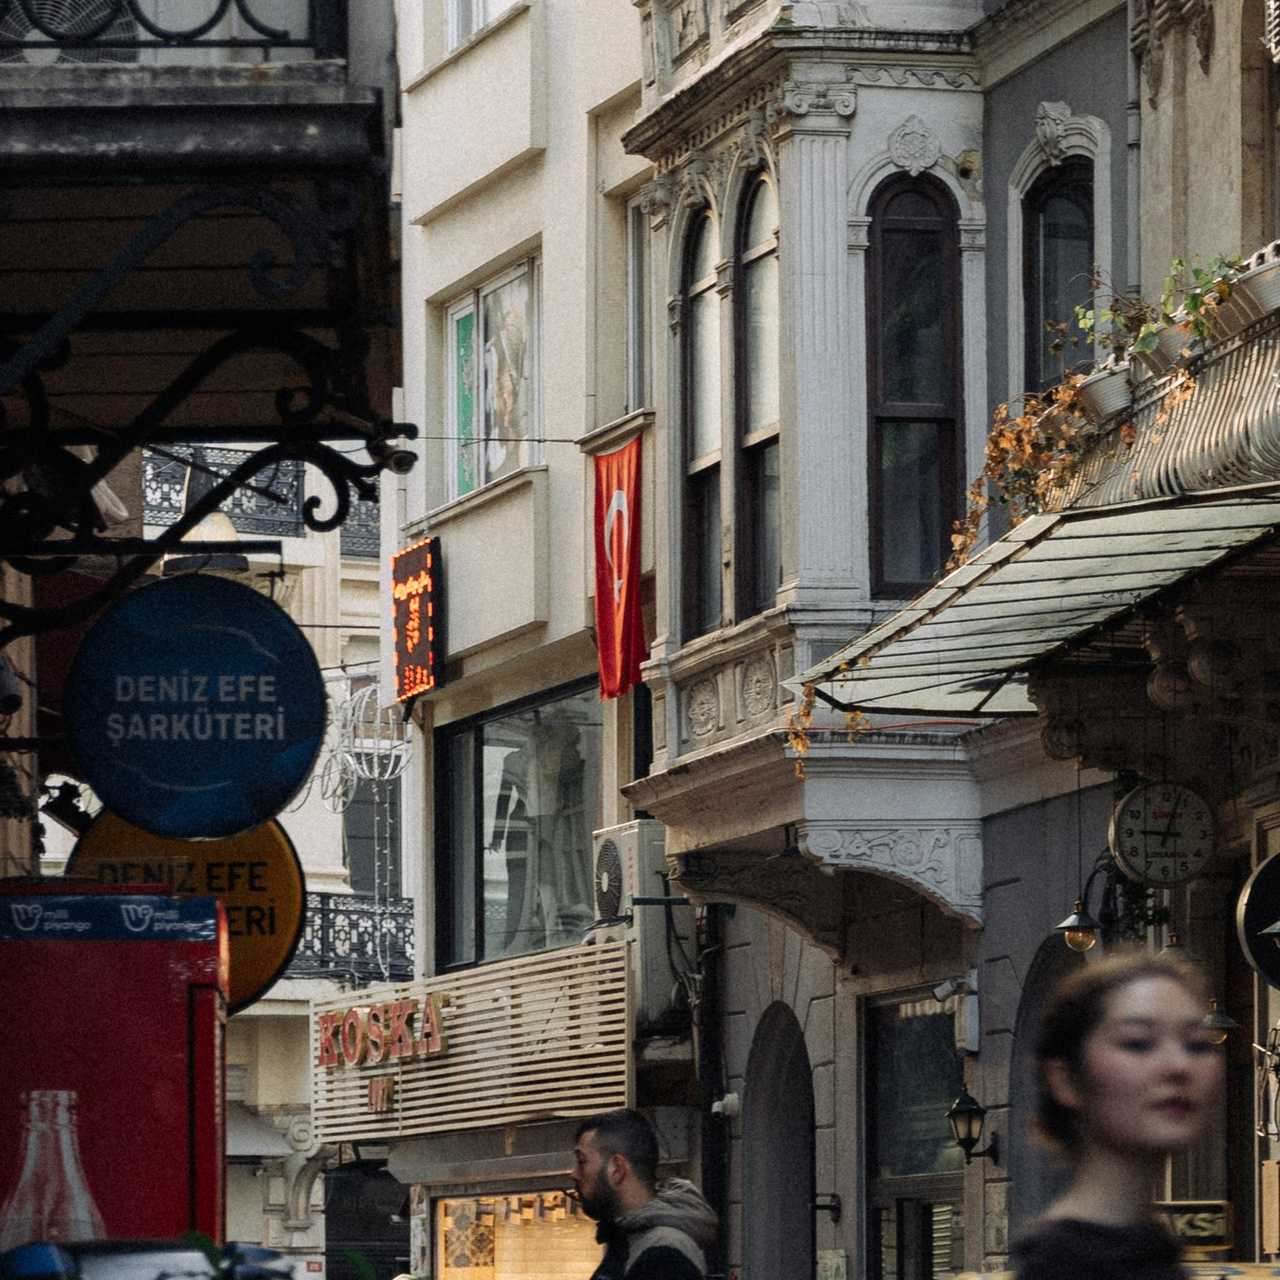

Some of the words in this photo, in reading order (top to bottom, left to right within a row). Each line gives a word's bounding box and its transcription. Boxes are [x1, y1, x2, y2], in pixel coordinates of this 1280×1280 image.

[115, 669, 209, 702] DENİZ
[218, 675, 277, 702] EFE
[106, 706, 286, 747] ŞARKÜTERİ
[206, 861, 268, 893] EFE
[316, 993, 446, 1069] KOSKA
